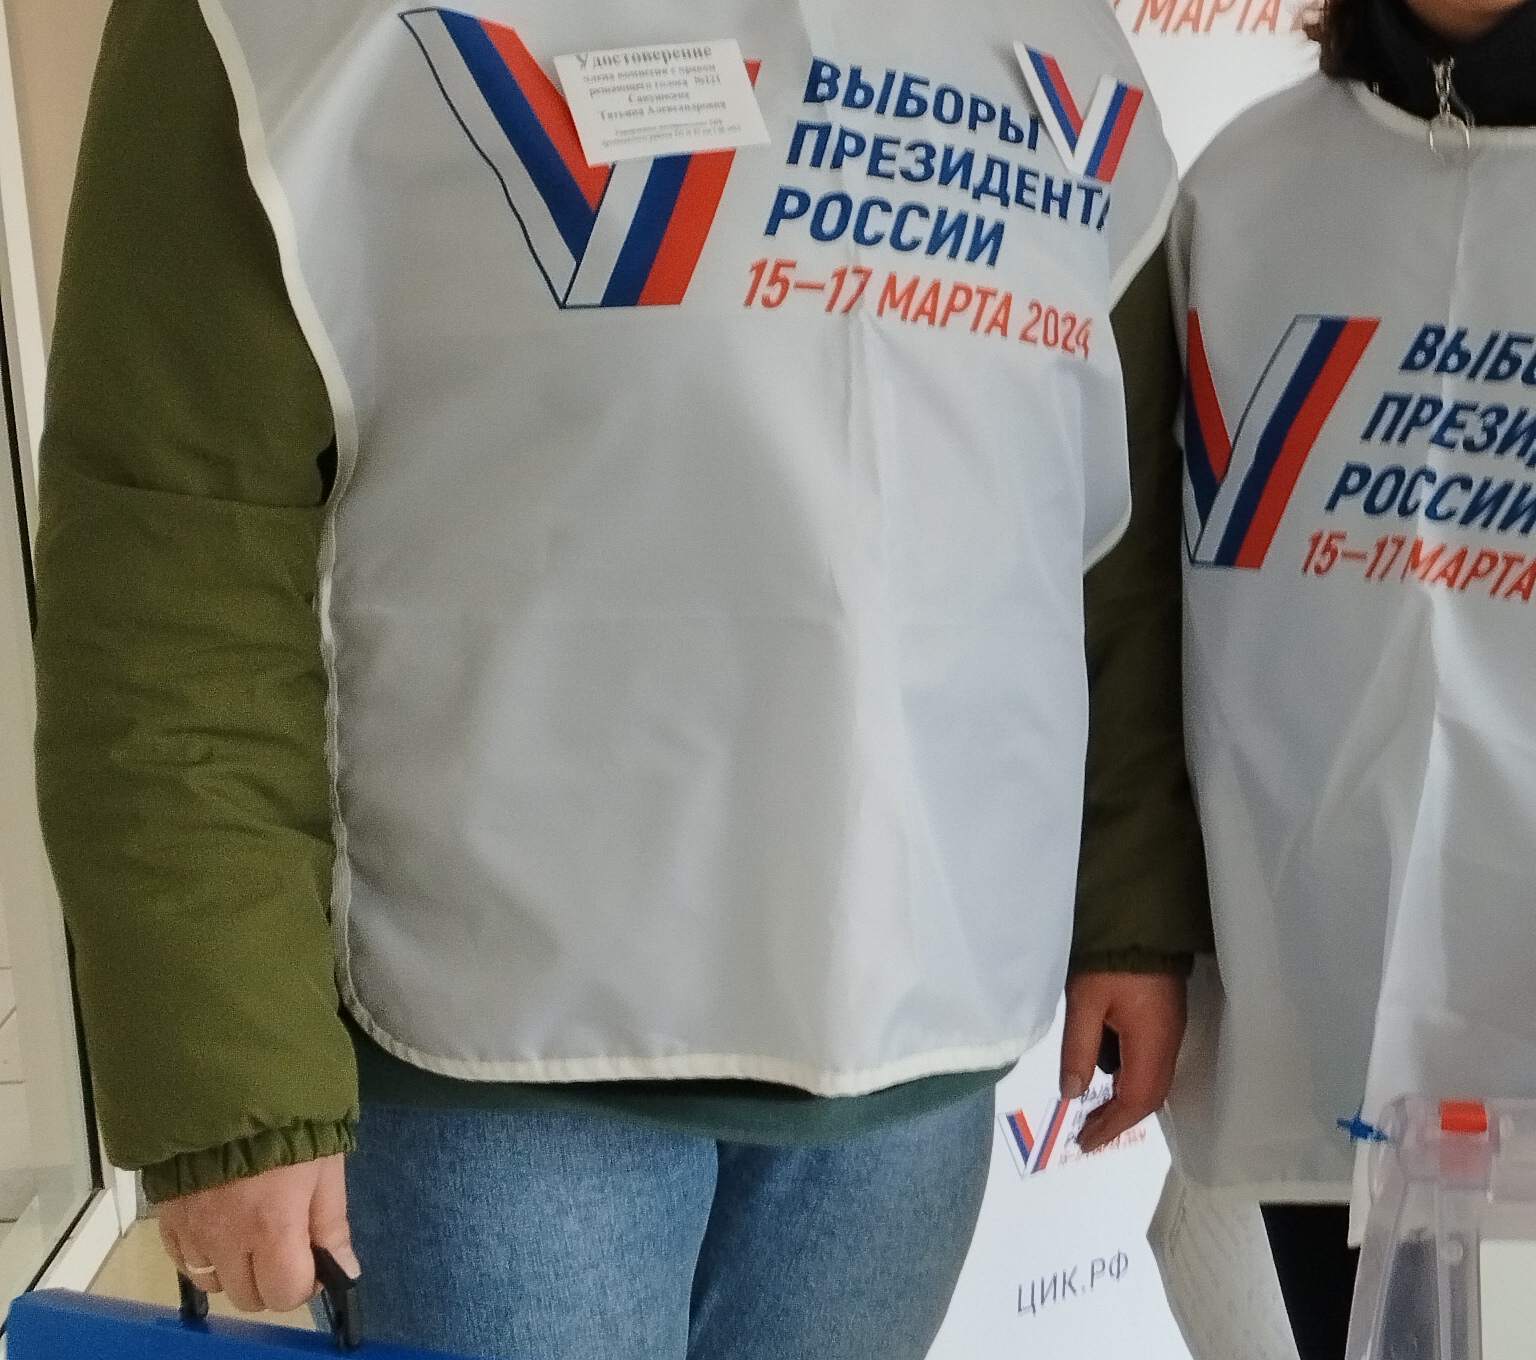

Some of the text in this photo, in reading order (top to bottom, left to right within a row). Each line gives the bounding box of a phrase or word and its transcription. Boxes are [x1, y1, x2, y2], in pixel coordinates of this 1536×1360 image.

[574, 46, 712, 69] Удостоверение
[802, 56, 1042, 151] ВЫБОРЫ
[763, 184, 1005, 269] РОССИИ
[877, 271, 1013, 338] МАРТА
[1019, 298, 1092, 360] 2024
[1017, 1249, 1130, 1317] ЦИК.РФ
